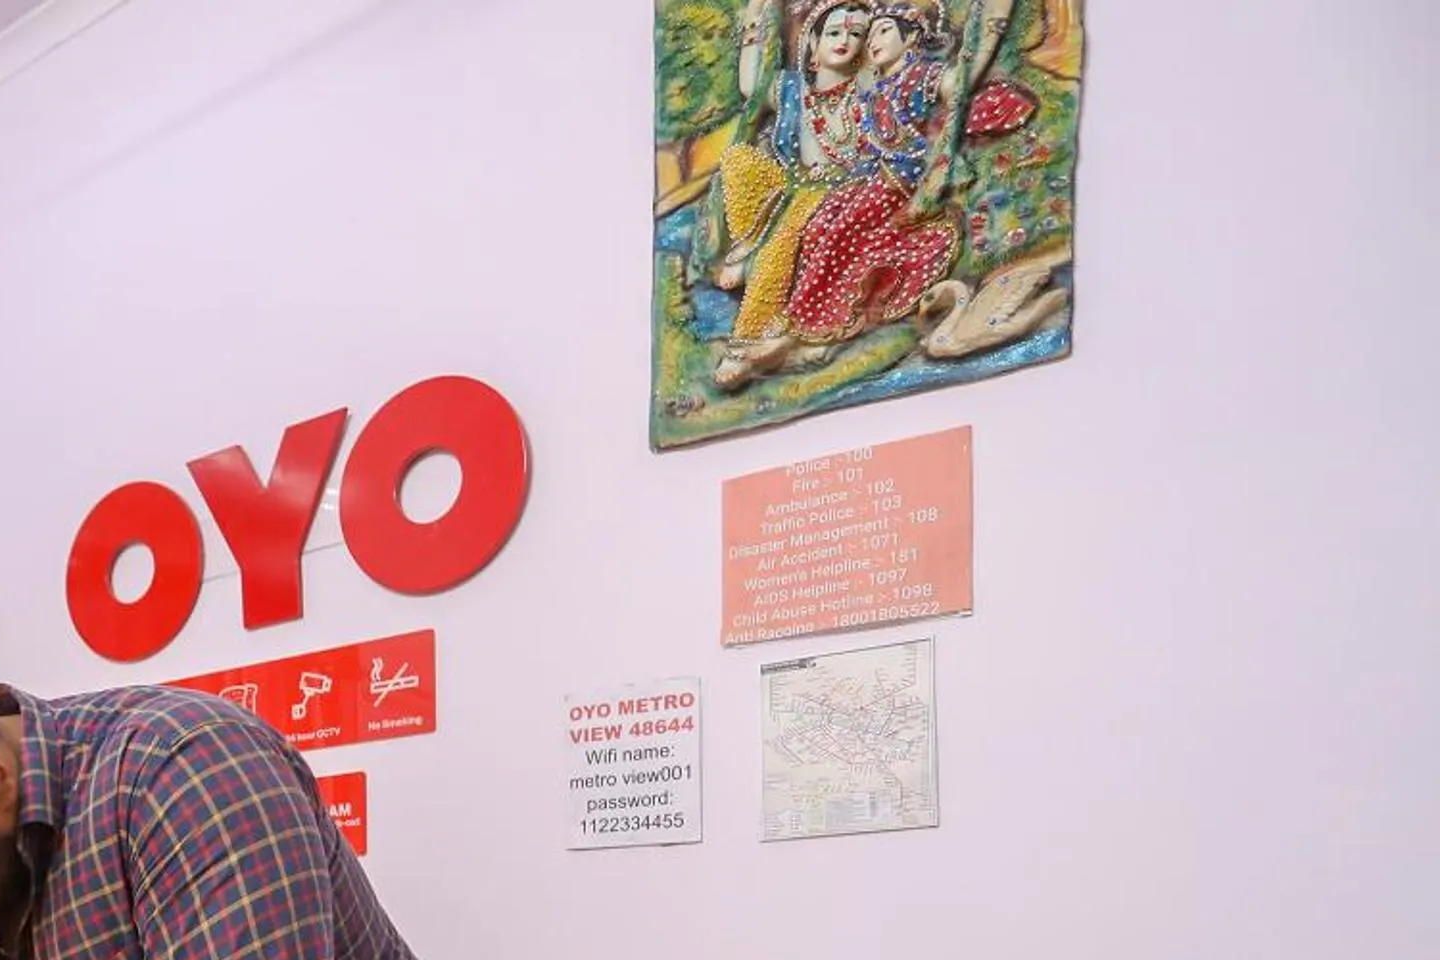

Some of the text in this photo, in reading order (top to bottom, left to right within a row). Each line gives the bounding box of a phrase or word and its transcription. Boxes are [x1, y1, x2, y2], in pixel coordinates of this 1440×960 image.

[838, 467, 863, 485] 101
[765, 491, 848, 518] Ambulance
[867, 477, 895, 496] 102
[66, 375, 533, 664] OYO
[760, 516, 806, 535] Traffic
[809, 507, 854, 523] Police
[872, 494, 902, 516] 103
[728, 506, 939, 560] Disaster Management 108
[757, 557, 776, 572] Air
[781, 543, 843, 567] Accident
[812, 557, 871, 580] Helpline
[754, 588, 789, 608] AIDS
[792, 580, 850, 599] Helpline
[868, 567, 907, 587] 1097
[732, 610, 767, 628] Child
[771, 603, 817, 620] Abuse
[820, 594, 874, 613] Hotline
[892, 582, 933, 601] 1098
[724, 629, 754, 644] Anti
[569, 692, 695, 721] OYO METRO
[316, 727, 341, 739] CCTV
[368, 715, 425, 731] No Smoking
[569, 715, 694, 744] VIEW 48644
[585, 745, 675, 765] Wifi name:
[569, 764, 692, 790] metro view001
[329, 801, 351, 818] AM
[586, 790, 674, 815] password:
[580, 812, 685, 835] 1122334455
